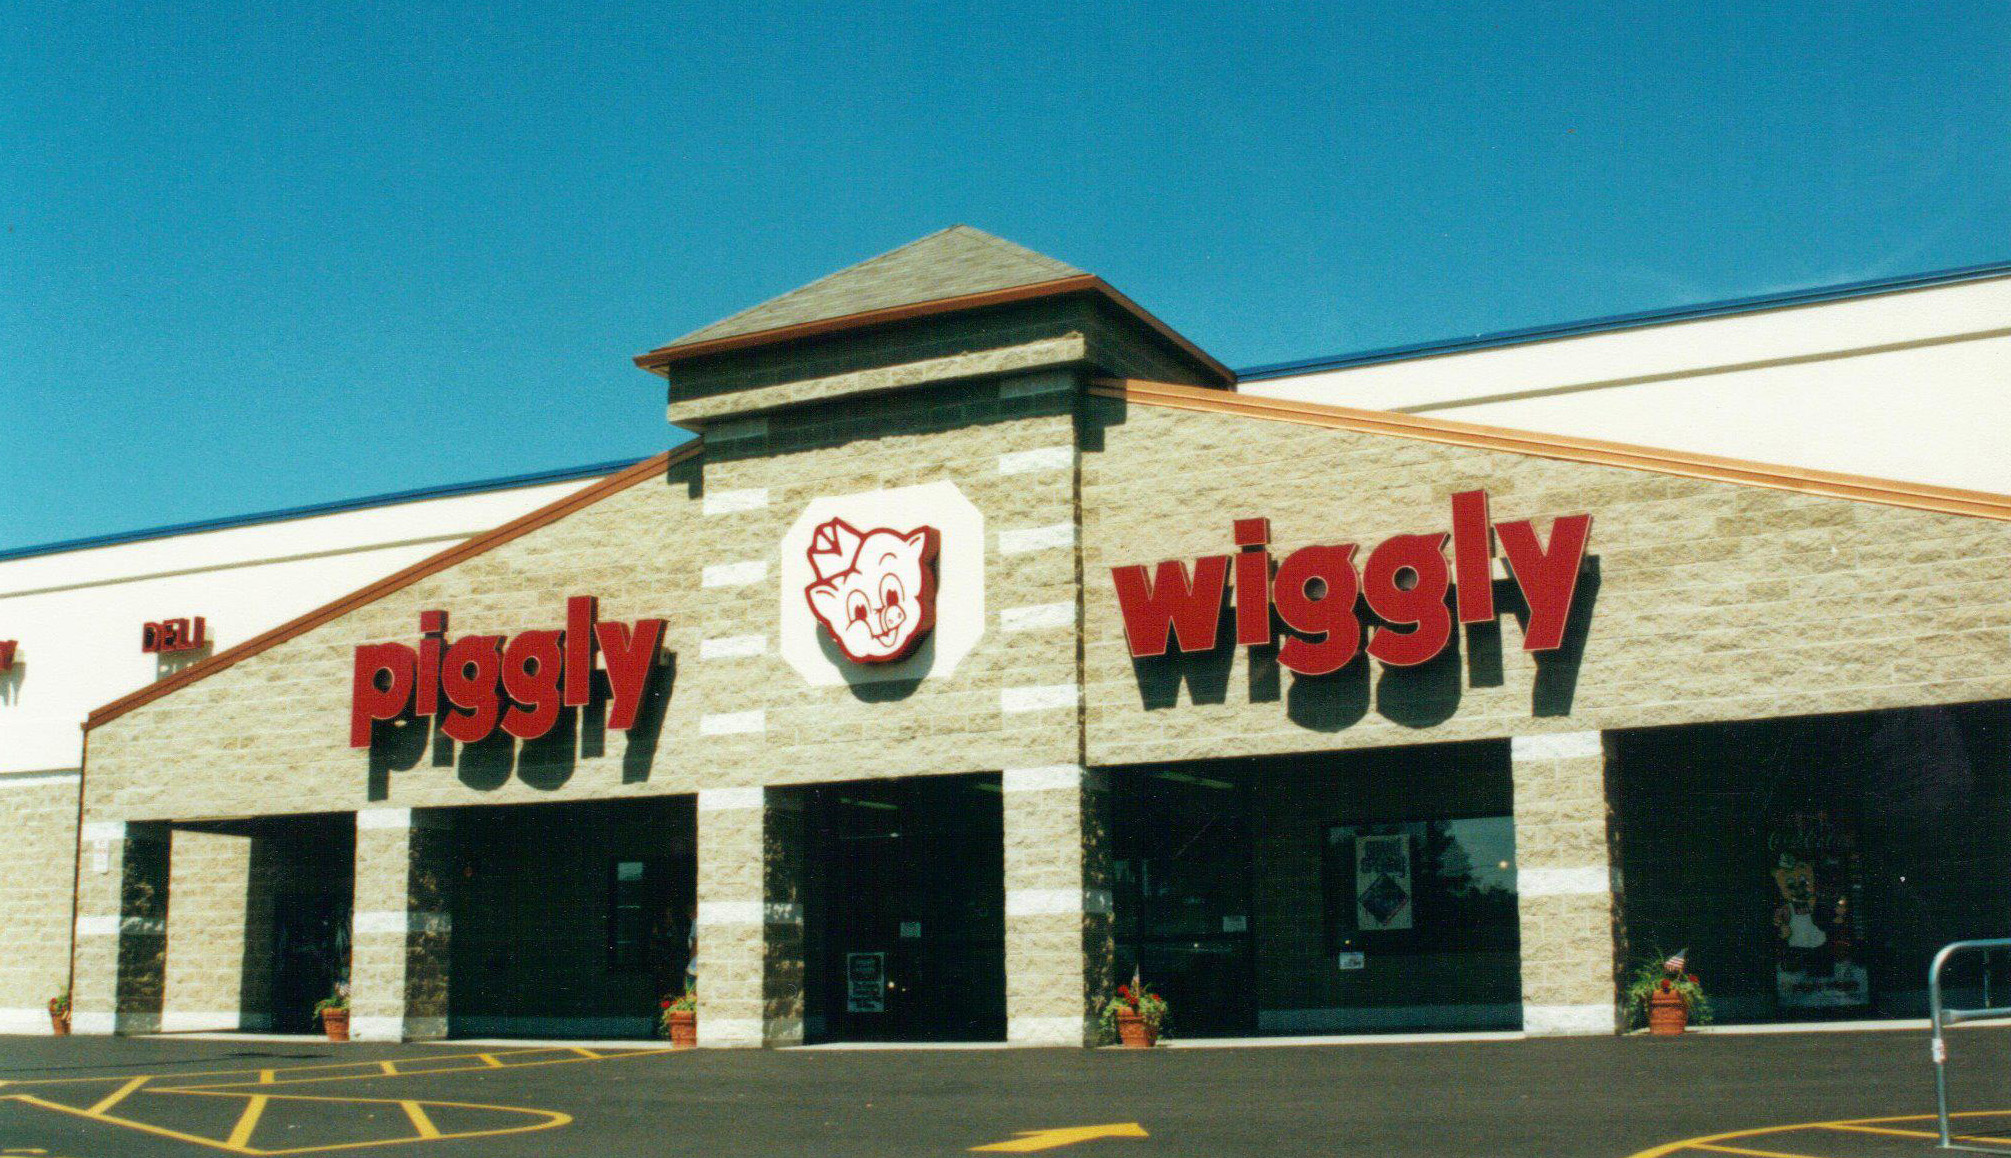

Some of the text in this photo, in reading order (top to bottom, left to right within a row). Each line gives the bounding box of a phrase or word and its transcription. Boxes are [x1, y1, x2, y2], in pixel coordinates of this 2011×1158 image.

[142, 616, 206, 652] DELI
[351, 490, 1592, 748] piggly wiggly
